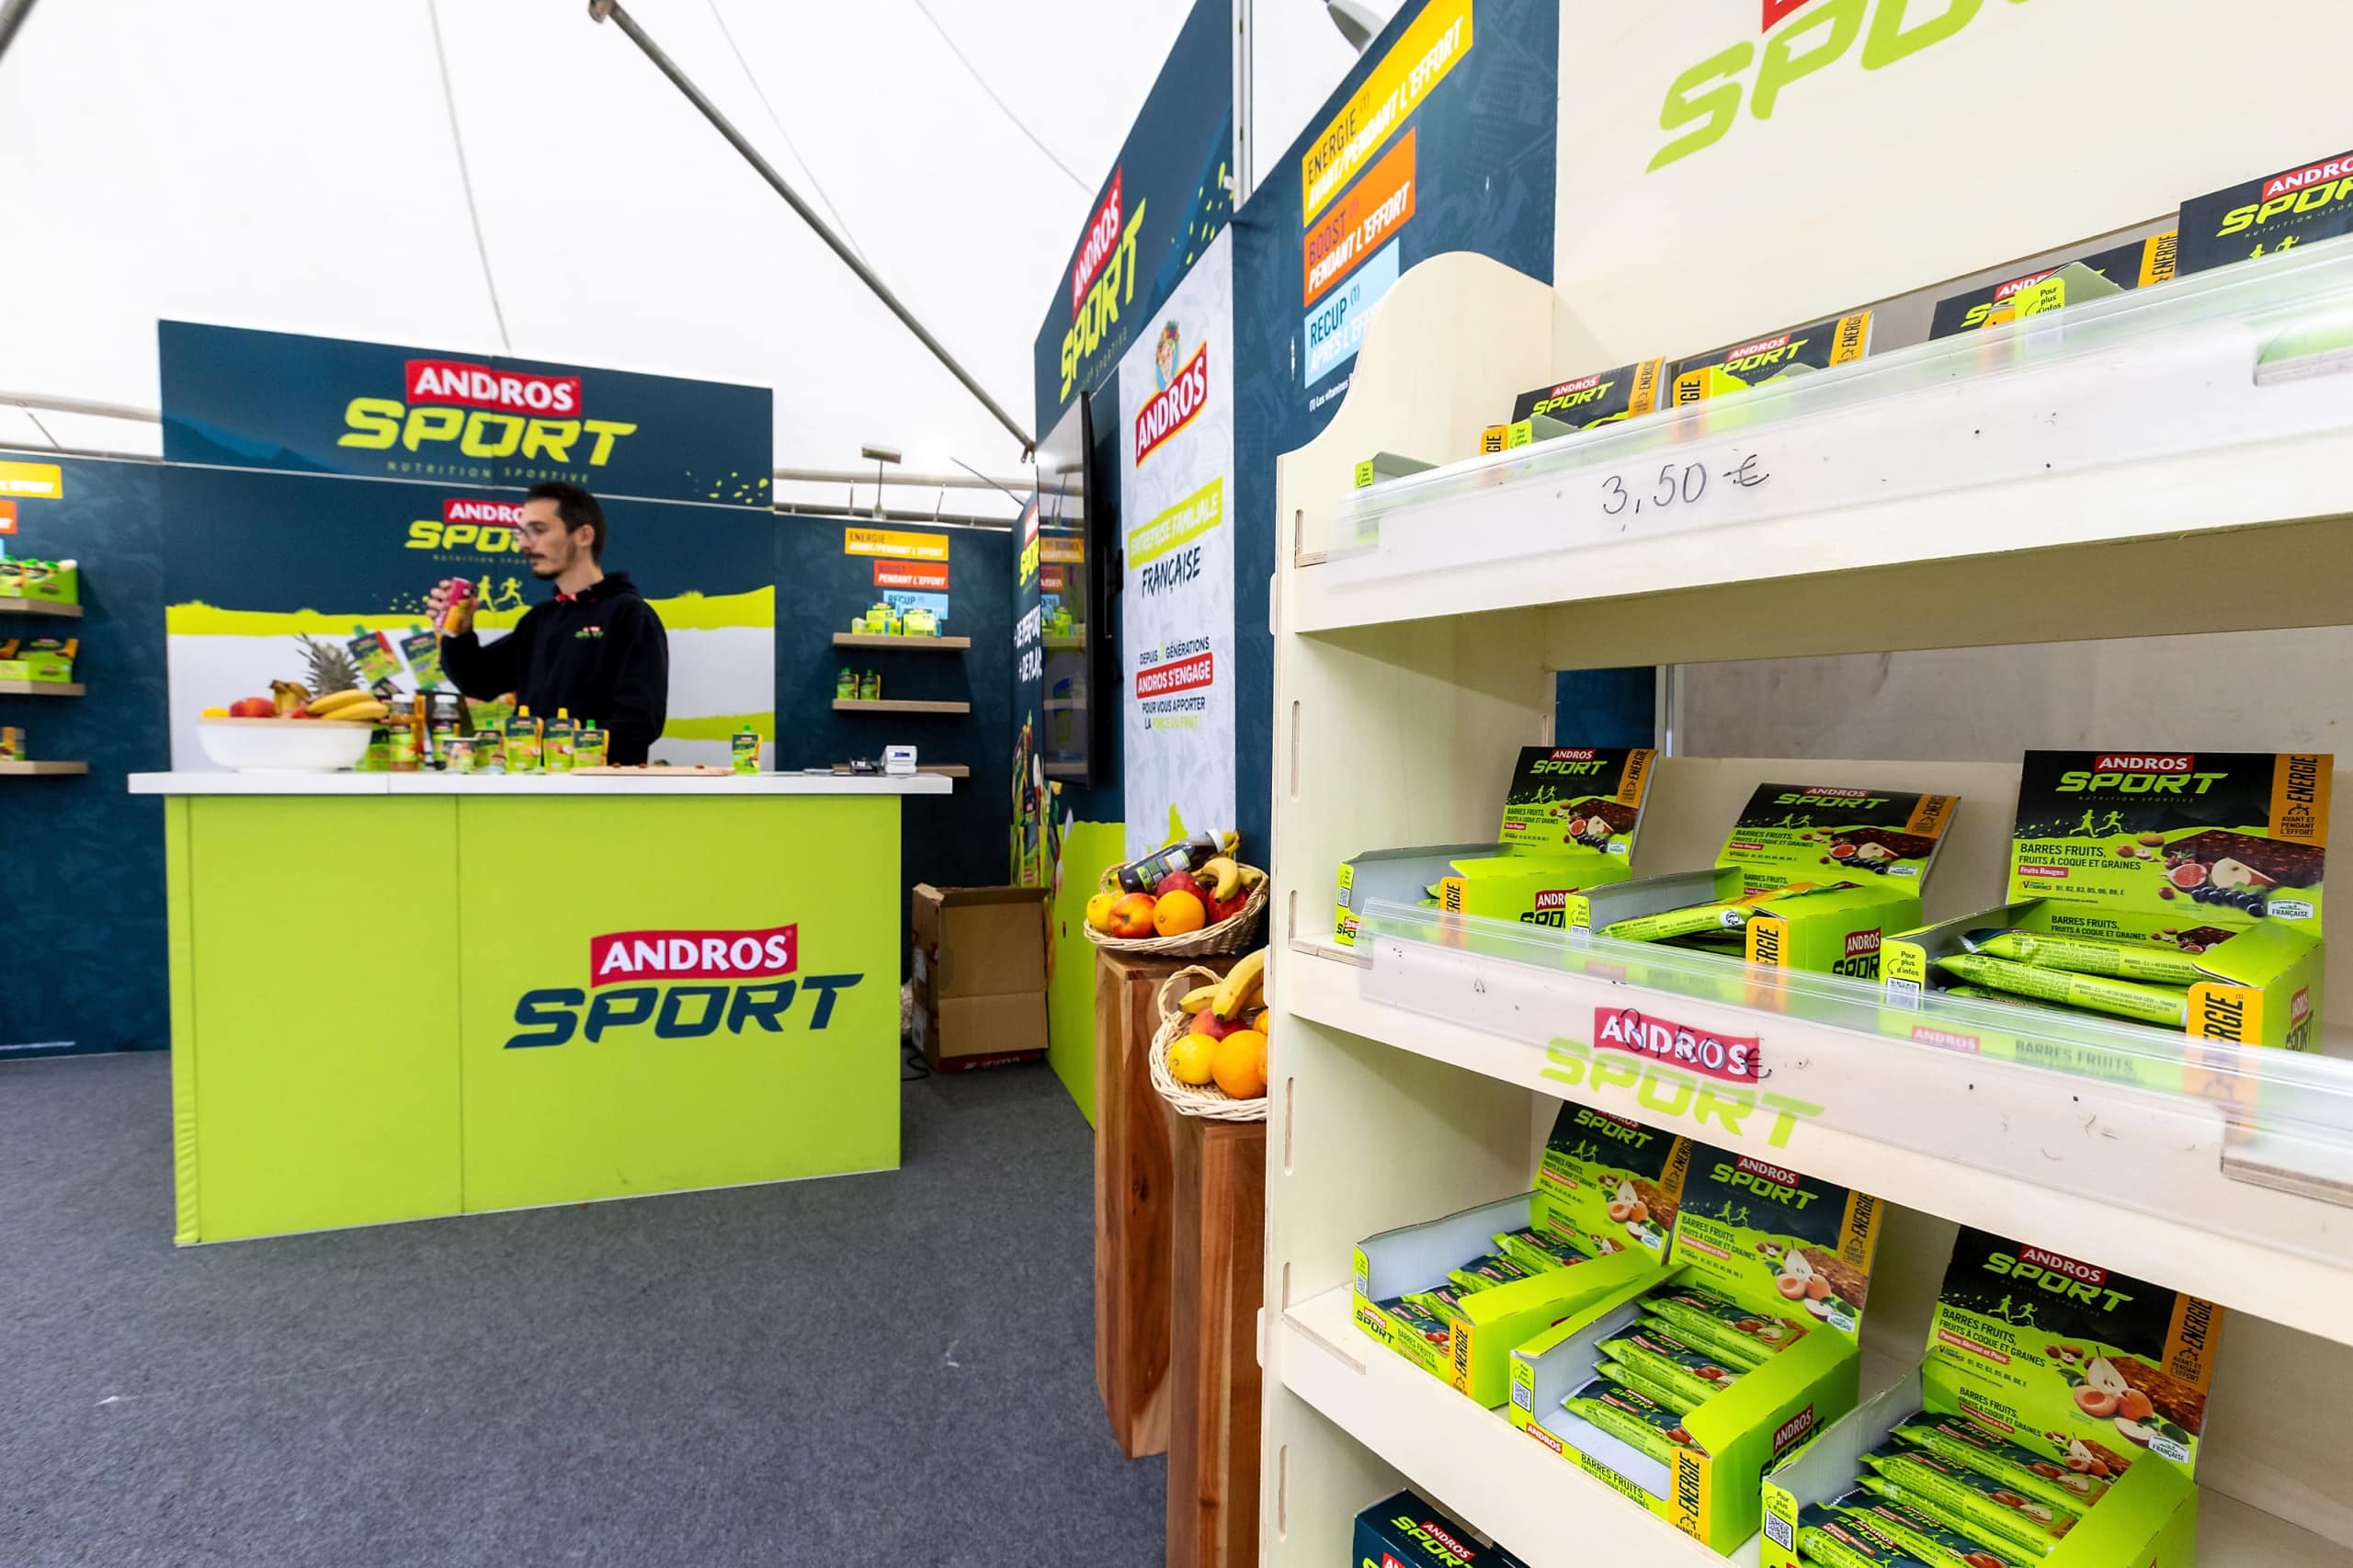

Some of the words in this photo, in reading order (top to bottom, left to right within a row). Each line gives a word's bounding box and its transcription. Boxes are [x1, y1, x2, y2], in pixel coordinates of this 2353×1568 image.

[1645, 0, 2042, 174] SPO
[1308, 108, 1357, 185] ENERGIE
[2267, 158, 2353, 197] ANDRO
[1074, 188, 1119, 307] ANDROS
[1309, 212, 1346, 267] BOOST
[1309, 232, 1356, 294] PENDANT
[1060, 197, 1146, 404] SPORT
[1310, 297, 1347, 349] RECUP
[1729, 336, 1786, 359] ANDROS
[415, 367, 574, 412] ANDROS
[1530, 381, 1615, 416] SPORT
[1553, 378, 1597, 396] ANDROS
[1137, 357, 1205, 457] ANDROS
[336, 396, 638, 467] SPORT
[387, 461, 493, 479] NUTRITION
[504, 467, 589, 484] SPORTIVE
[405, 520, 521, 553] SPO
[849, 532, 885, 543] ENERGIE
[1142, 546, 1201, 598] FRANÇAISE
[1140, 649, 1158, 665] DEPUIS
[1165, 636, 1210, 659] GÉNÉRATIONS
[1138, 670, 1167, 693] ANDROS
[1168, 660, 1211, 687] S'ENGAGE
[1142, 700, 1156, 713] POUR
[1156, 699, 1172, 713] VOUS
[1172, 697, 1206, 712] APPORTER
[1144, 718, 1152, 730] LA
[1529, 760, 1608, 775] SPORT
[1552, 750, 1594, 759] ANDROS
[2098, 756, 2188, 771] ANDROS
[1807, 788, 1868, 798] ANDROS
[2055, 771, 2229, 795] SPORT
[2286, 756, 2318, 804] ENERGIE
[1773, 793, 1891, 810] SPORT
[1735, 829, 1762, 838] BARRES
[2020, 843, 2062, 855] BARRES
[2064, 846, 2107, 858] FRUITS,
[2018, 856, 2048, 865] FRUITS
[2057, 858, 2087, 868] COQUE
[2101, 860, 2141, 870] GRAINES
[2051, 915, 2086, 926] BARRES
[2086, 917, 2120, 930] FRUITS,
[2051, 925, 2075, 934] FRUITS
[2081, 927, 2105, 937] COQUE
[2116, 930, 2147, 940] GRAINES
[599, 934, 788, 976] ANDROS
[1846, 931, 1880, 954] ANDROS
[1901, 950, 1916, 960] Pour
[1896, 966, 1920, 976] d'infos
[1901, 959, 1915, 967] plus
[503, 972, 865, 1050] SPORT
[1600, 1015, 1750, 1075] ANDROS
[1539, 1036, 1825, 1150] SPORT
[1574, 1108, 1654, 1149] SPORT
[1709, 1163, 1819, 1210] SPORT
[1739, 1158, 1796, 1184] ANDROS
[1682, 1215, 1709, 1233] BARRES
[1983, 1252, 2134, 1312] SPORT
[2022, 1248, 2103, 1283] ANDROS
[1356, 1310, 1394, 1344] SPORT
[1942, 1308, 1979, 1330] BARRES
[1980, 1324, 2017, 1346] FRUITS,
[2180, 1295, 2213, 1351] ENERGIE
[1454, 1324, 1469, 1378] ENERGIE
[1939, 1319, 1965, 1335] FRUITS
[1972, 1333, 1998, 1349] COQUE
[1999, 1343, 2009, 1352] ET
[2010, 1347, 2046, 1368] GRAINES
[1960, 1386, 1989, 1406] BARRES
[1990, 1400, 2018, 1419] FRUITS,
[1527, 1425, 1562, 1452] ANDROS
[1775, 1408, 1812, 1449] ANDROS
[1581, 1453, 1611, 1480] BARRES
[1678, 1452, 1700, 1518] ENERGIE
[1776, 1491, 1790, 1502] Pour
[1390, 1516, 1473, 1568] SPOR
[1425, 1524, 1471, 1560] ANDROS
